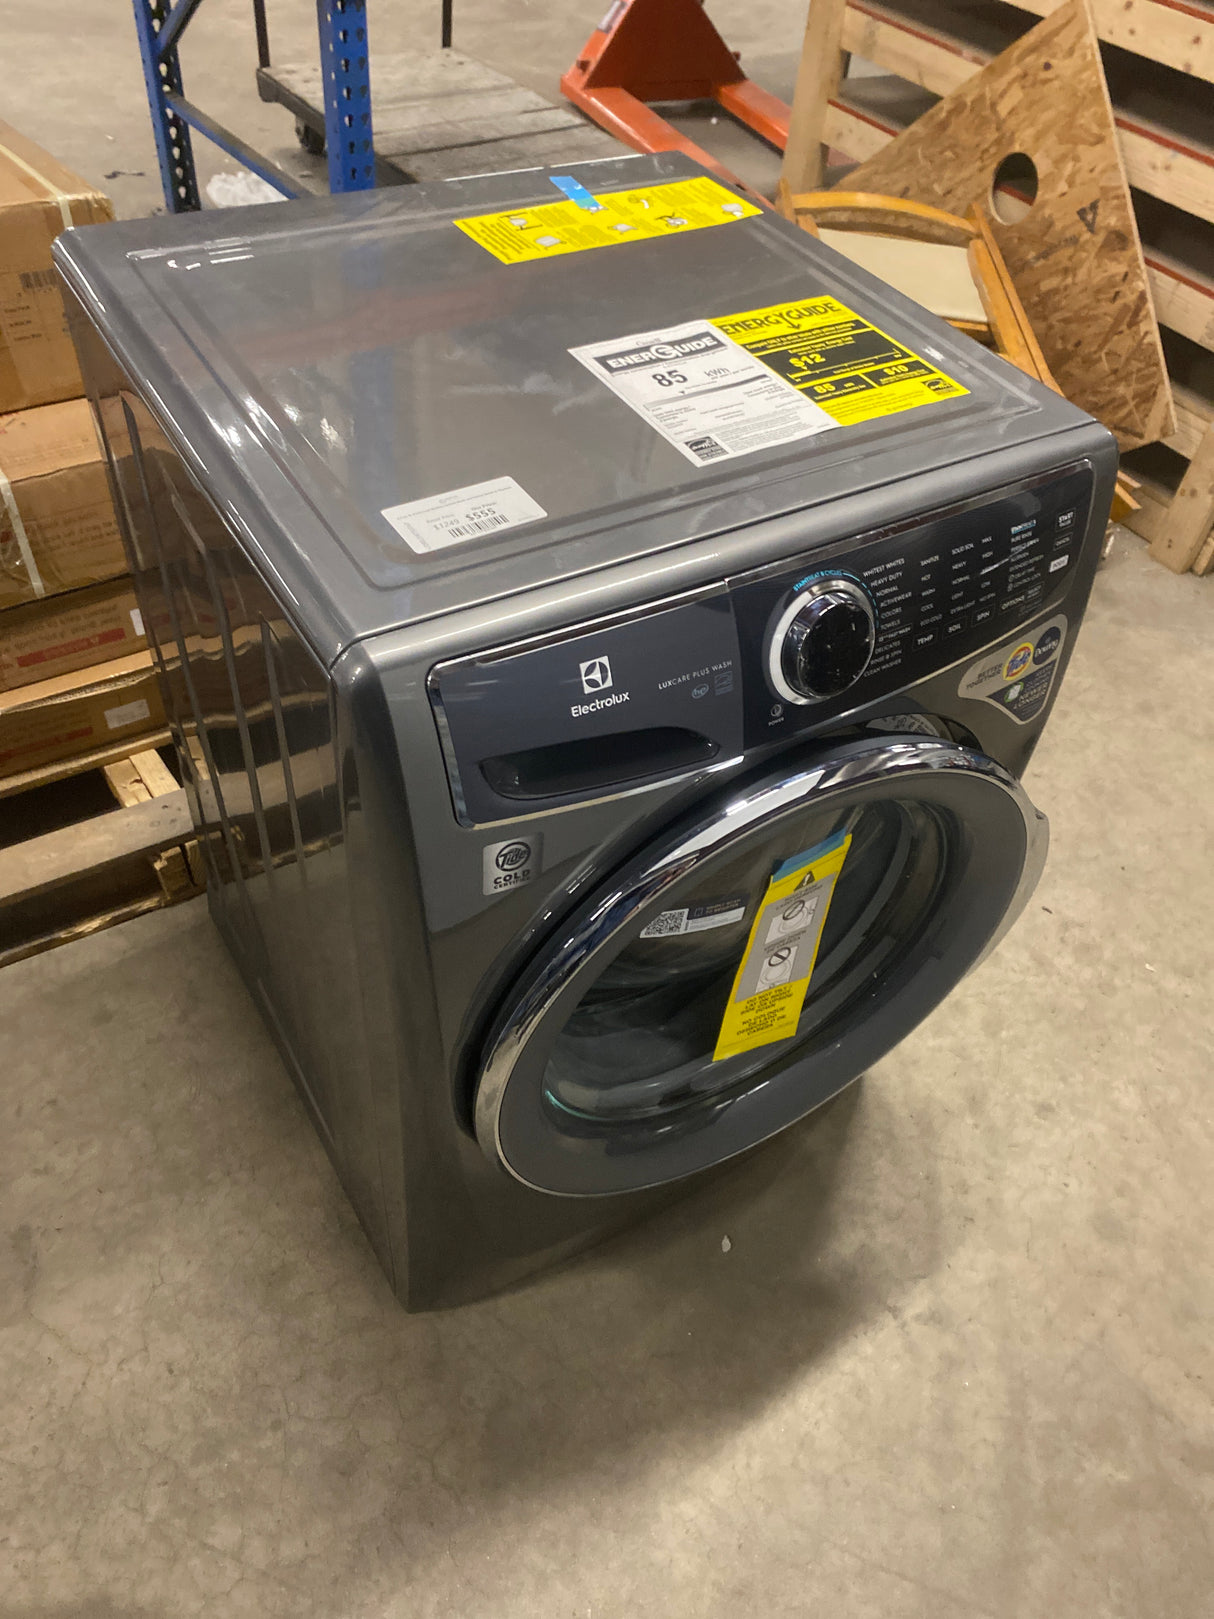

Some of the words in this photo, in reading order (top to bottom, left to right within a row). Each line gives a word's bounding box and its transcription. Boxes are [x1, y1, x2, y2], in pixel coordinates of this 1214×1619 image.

[606, 336, 718, 368] ENERGUIDE
[789, 353, 826, 367] $12
[652, 370, 688, 387] 85
[465, 508, 496, 521] $555
[863, 566, 886, 577] WHITEST
[886, 558, 905, 569] WHITES
[870, 576, 889, 587] HEAVY
[889, 571, 903, 581] DUTY
[876, 585, 899, 597] NORMAL
[880, 592, 912, 607] ACTIVEWEAR
[881, 607, 902, 619] COLORS
[880, 619, 901, 630] TOWELS
[917, 634, 933, 645] TEMP
[658, 675, 691, 690] LUXCARE
[692, 667, 709, 678] PLUS
[711, 660, 733, 671] WASH
[571, 691, 630, 718] Electrolux
[494, 870, 530, 885] COLD
